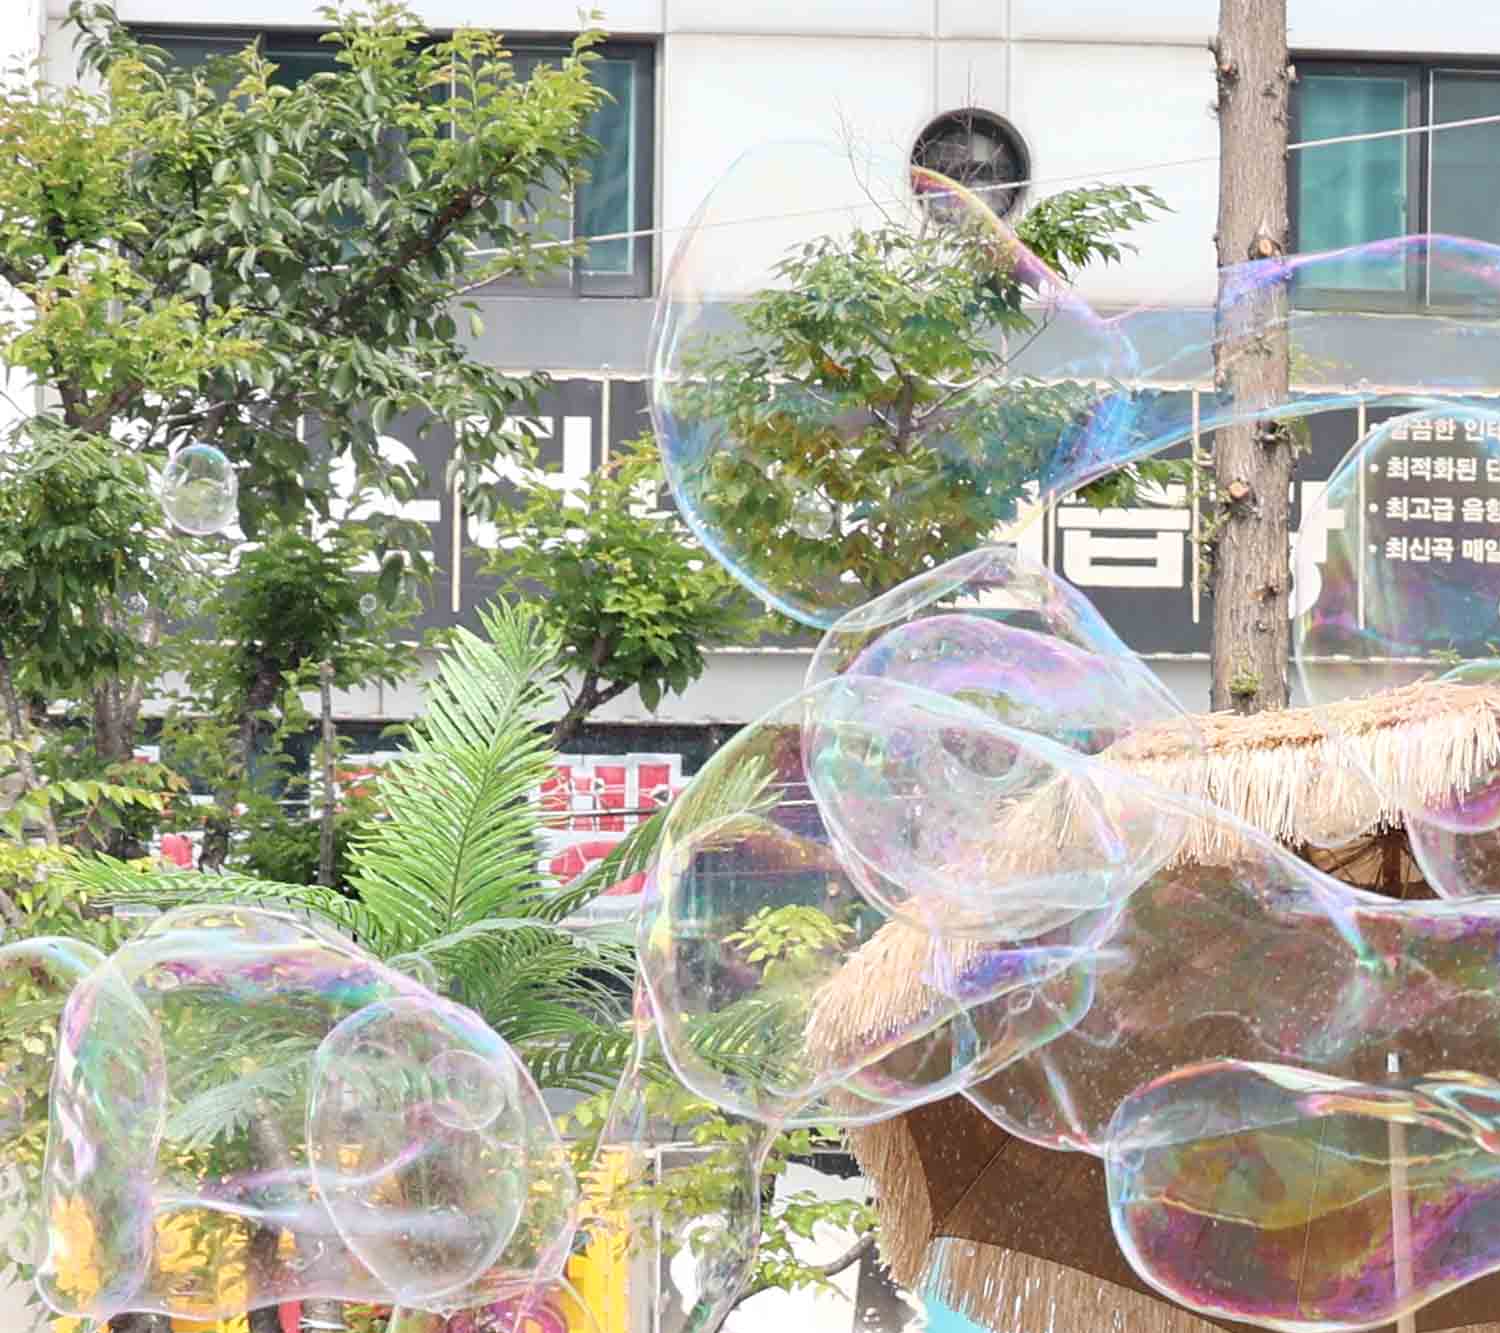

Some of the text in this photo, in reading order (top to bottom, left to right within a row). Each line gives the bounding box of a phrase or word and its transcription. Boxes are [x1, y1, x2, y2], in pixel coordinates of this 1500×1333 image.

[1386, 456, 1478, 482] 최적화된
[1386, 497, 1455, 522] 최고급
[1385, 537, 1455, 563] 최신곡
